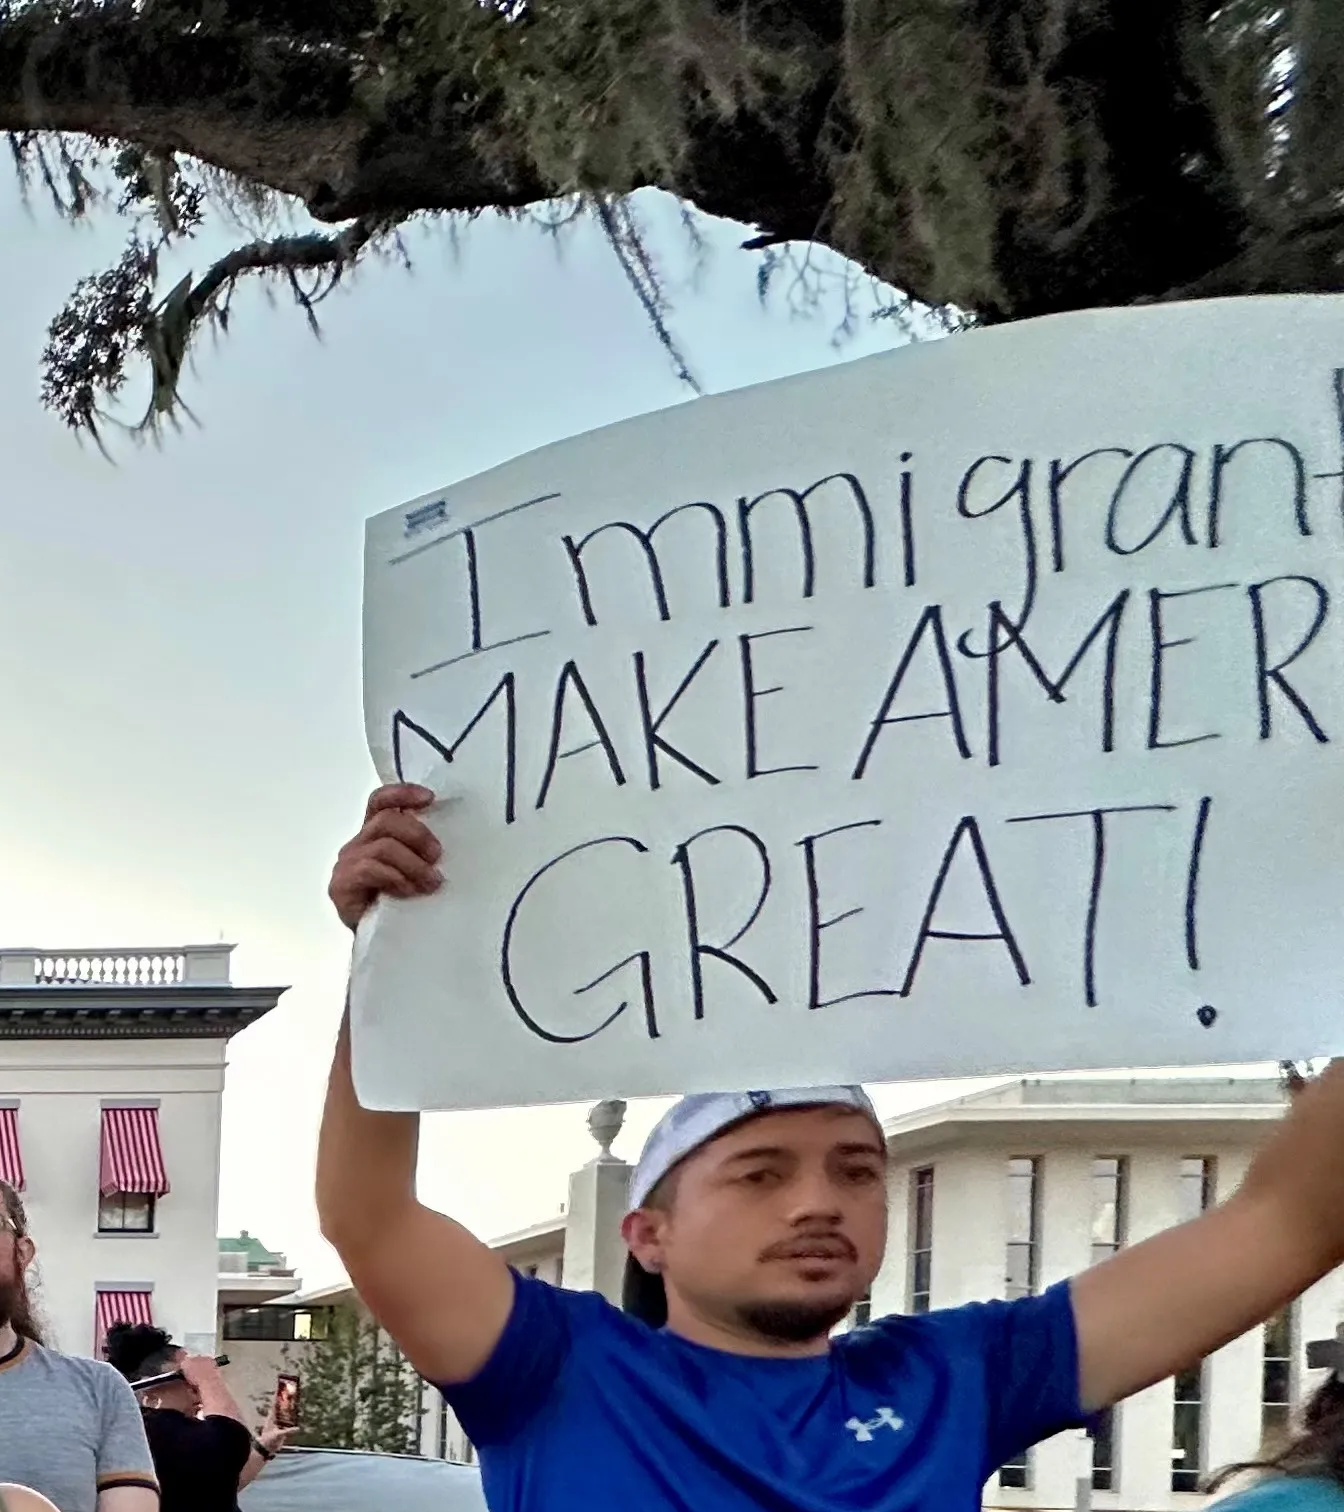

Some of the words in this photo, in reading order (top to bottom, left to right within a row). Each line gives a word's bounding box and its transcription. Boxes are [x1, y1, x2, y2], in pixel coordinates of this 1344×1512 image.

[393, 625, 819, 824] MAKE
[852, 575, 1331, 780] AMER
[501, 796, 1219, 1044] GREAT!
